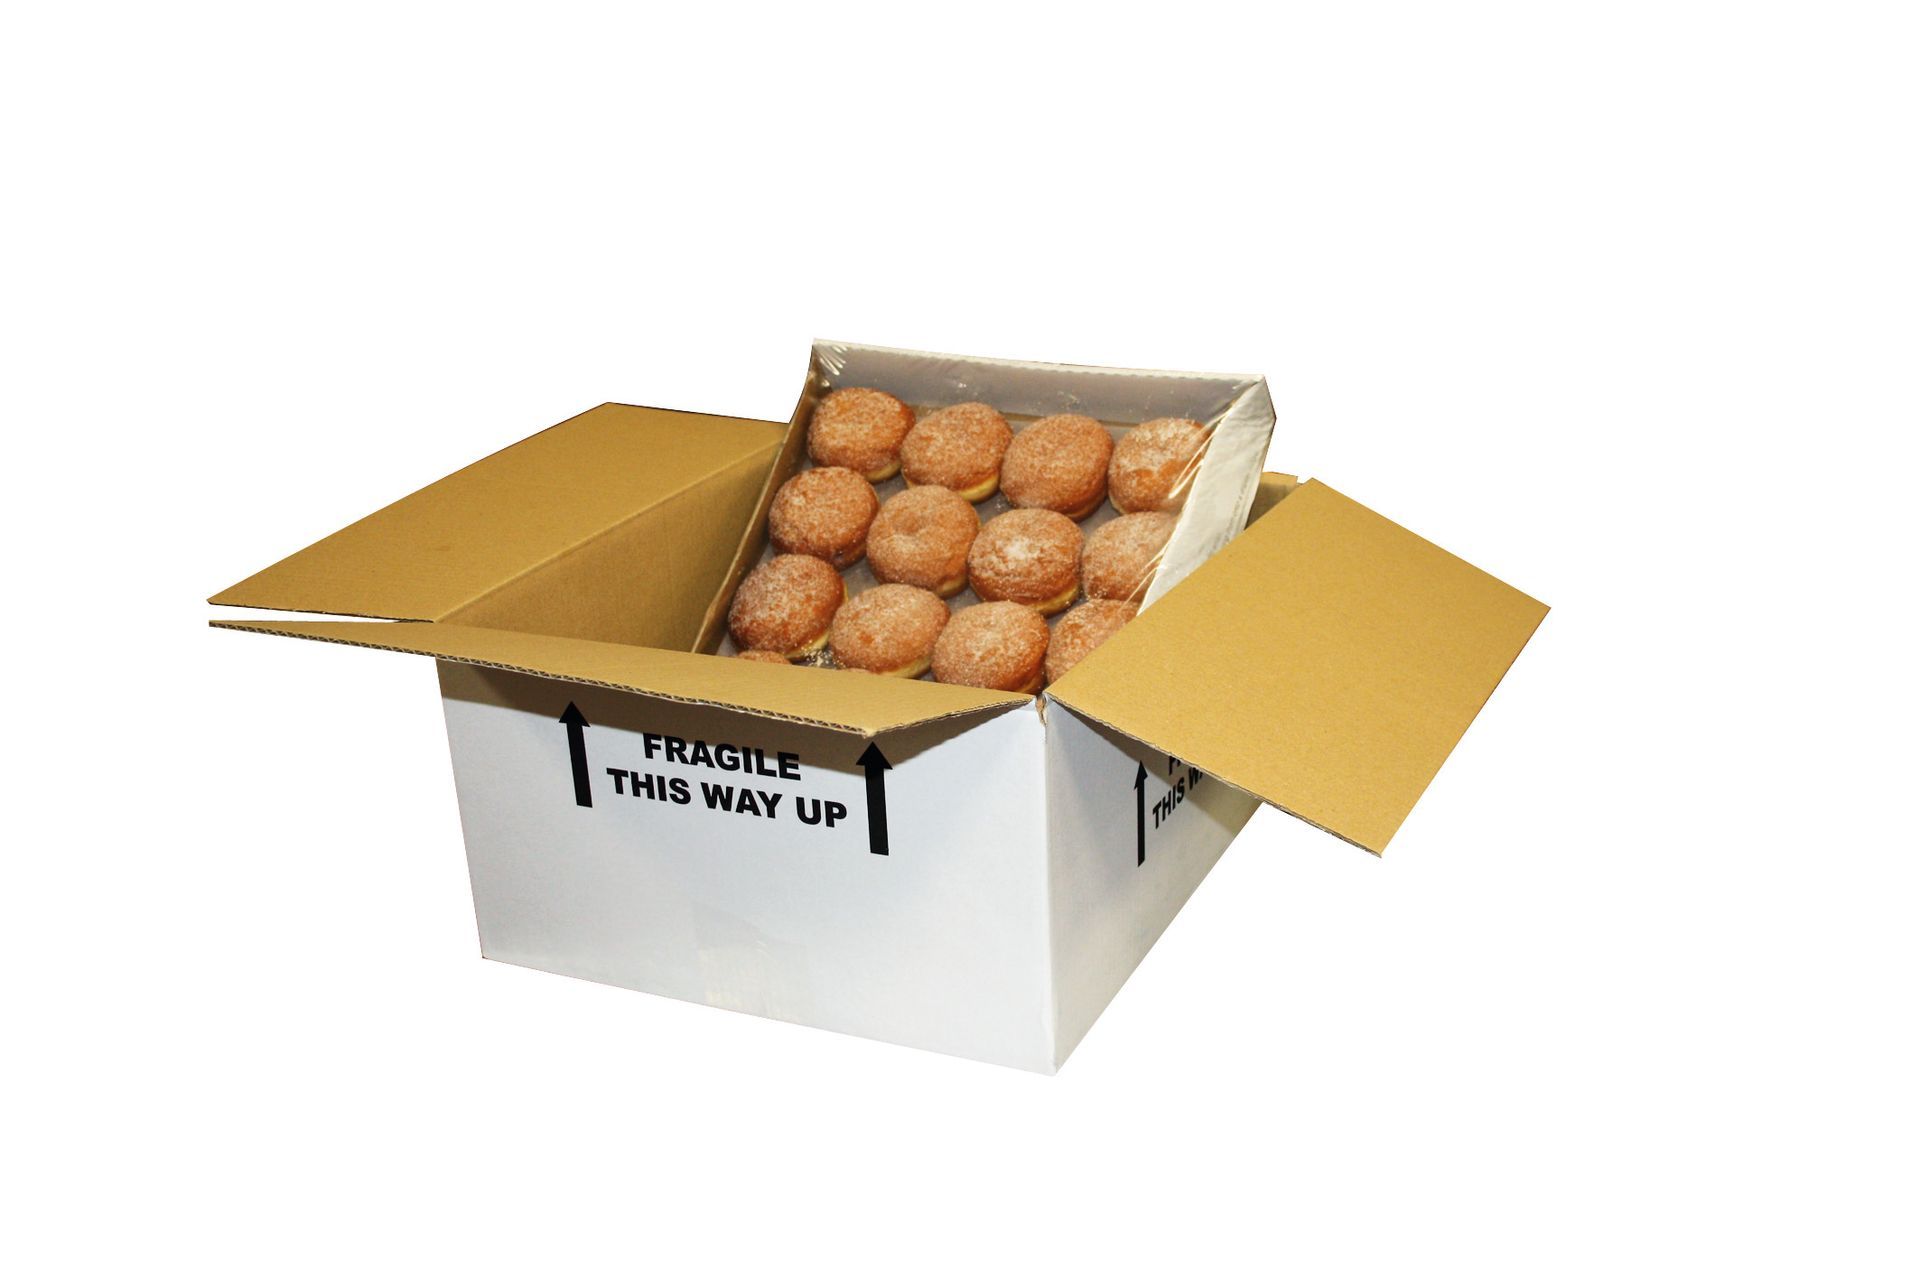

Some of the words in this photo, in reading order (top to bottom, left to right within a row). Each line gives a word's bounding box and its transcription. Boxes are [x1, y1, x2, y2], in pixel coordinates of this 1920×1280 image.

[642, 732, 801, 782] FRAGILE
[606, 767, 692, 805] THIS
[700, 782, 783, 819] WAY
[796, 796, 848, 828] UP
[1152, 777, 1186, 830] THIS
